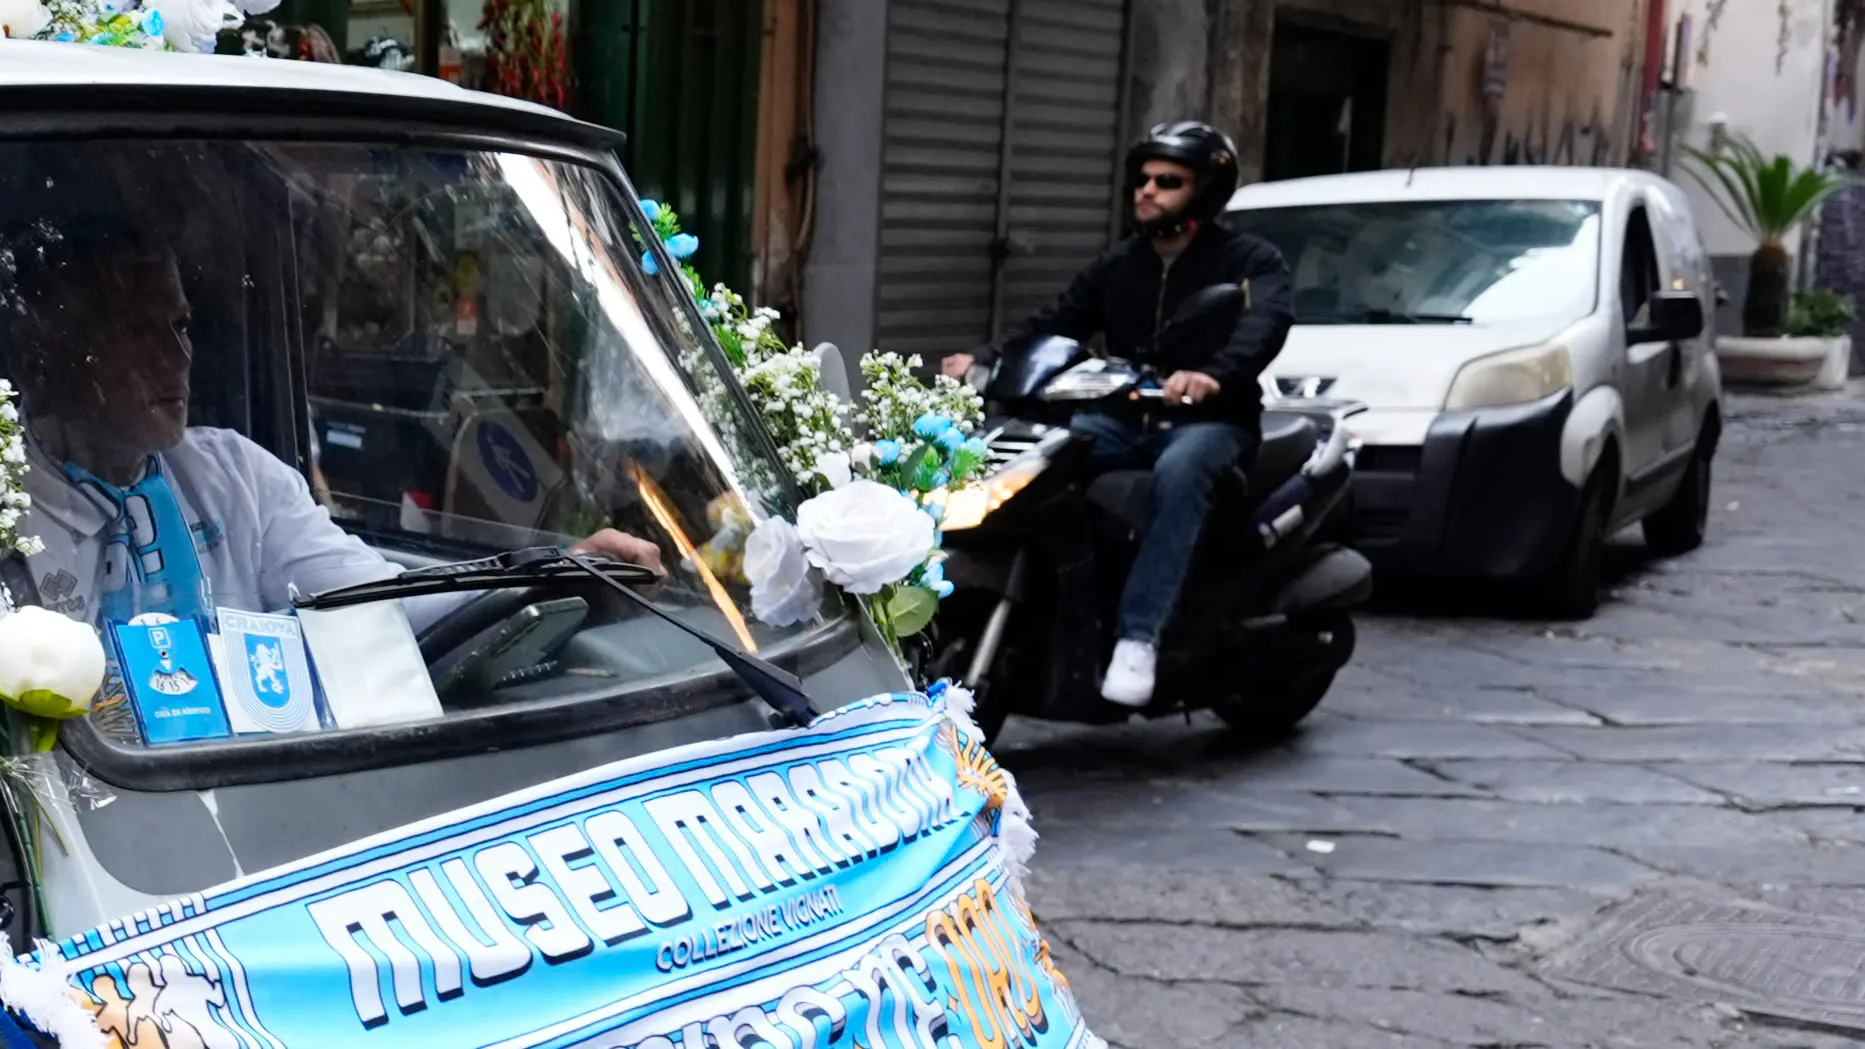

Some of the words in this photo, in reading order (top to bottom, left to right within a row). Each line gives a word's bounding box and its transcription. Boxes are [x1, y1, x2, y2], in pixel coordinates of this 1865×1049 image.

[305, 809, 693, 1031] MUSEO
[642, 735, 974, 911] MARADONA
[655, 908, 783, 974] COLLEZIONE
